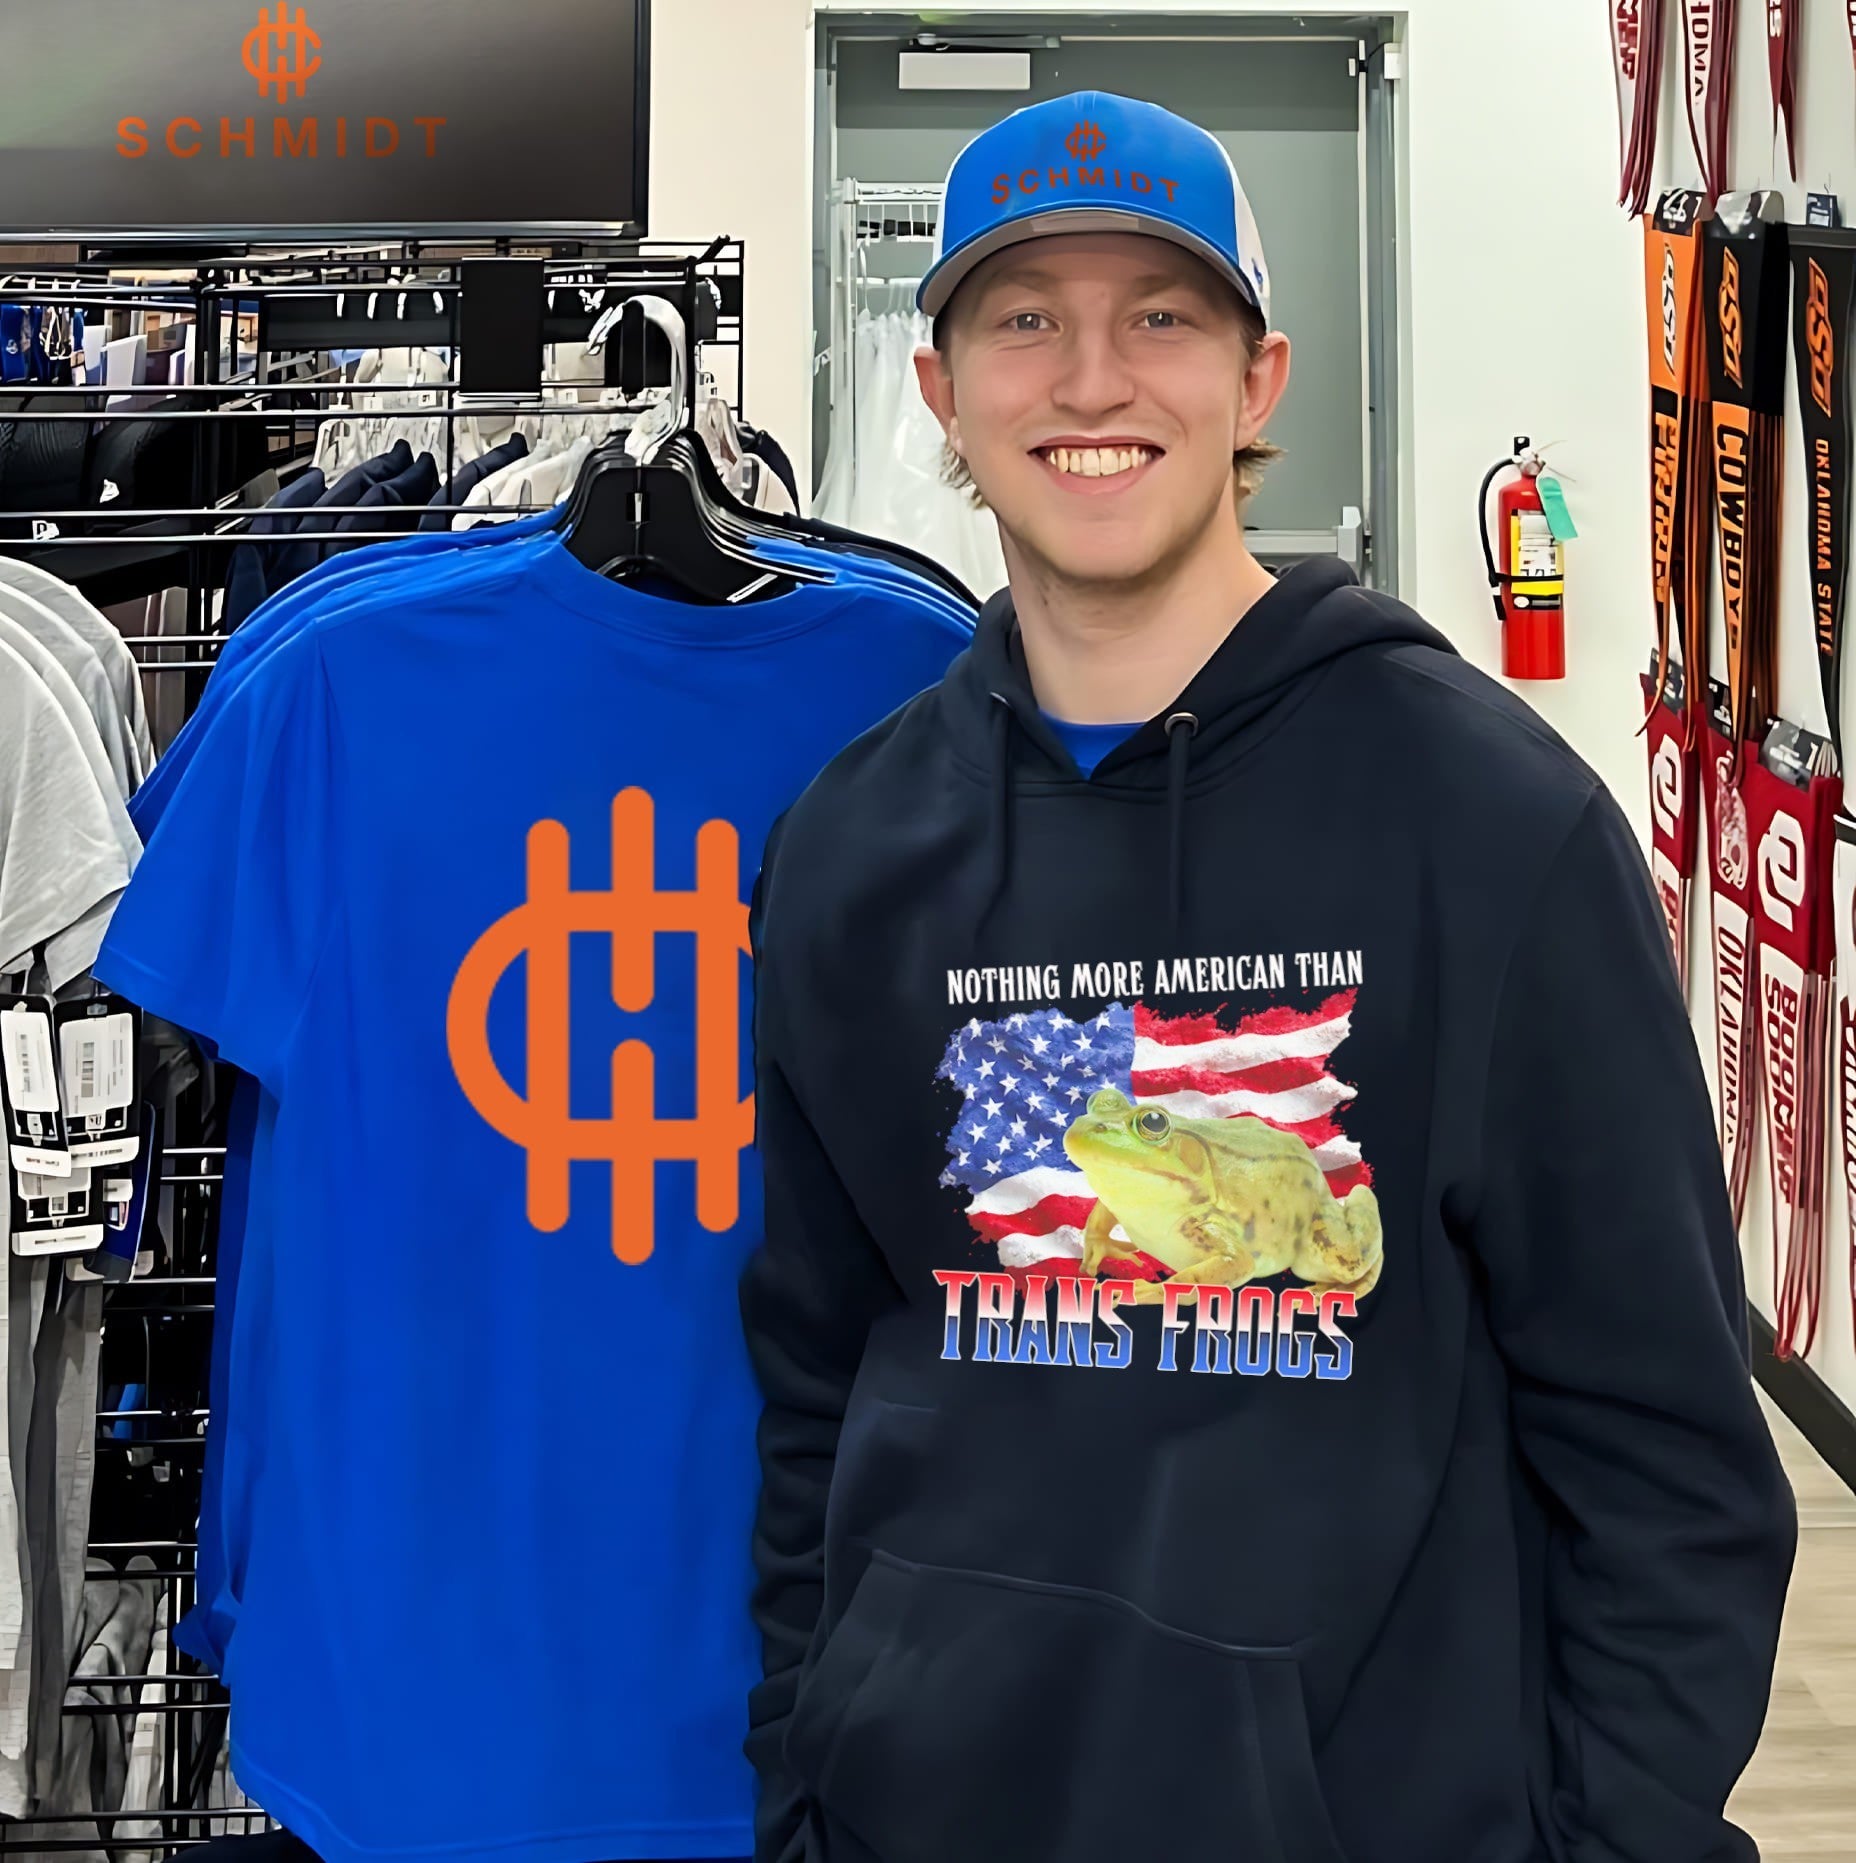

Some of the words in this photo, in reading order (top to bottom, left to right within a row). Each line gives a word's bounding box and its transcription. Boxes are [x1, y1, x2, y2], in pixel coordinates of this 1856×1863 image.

[115, 116, 447, 159] SCHMIDT
[991, 166, 1179, 204] SCHMIDT
[1815, 438, 1832, 570] OKLAHOMA
[947, 964, 1061, 1005] NOTHING
[1070, 960, 1144, 999] MORE
[1154, 953, 1286, 995] AMERICAN
[1294, 950, 1364, 988] THAN
[1718, 926, 1745, 1144] OKLAHOMA
[932, 1269, 1137, 1369] TRANS
[1156, 1282, 1359, 1381] FROGS
